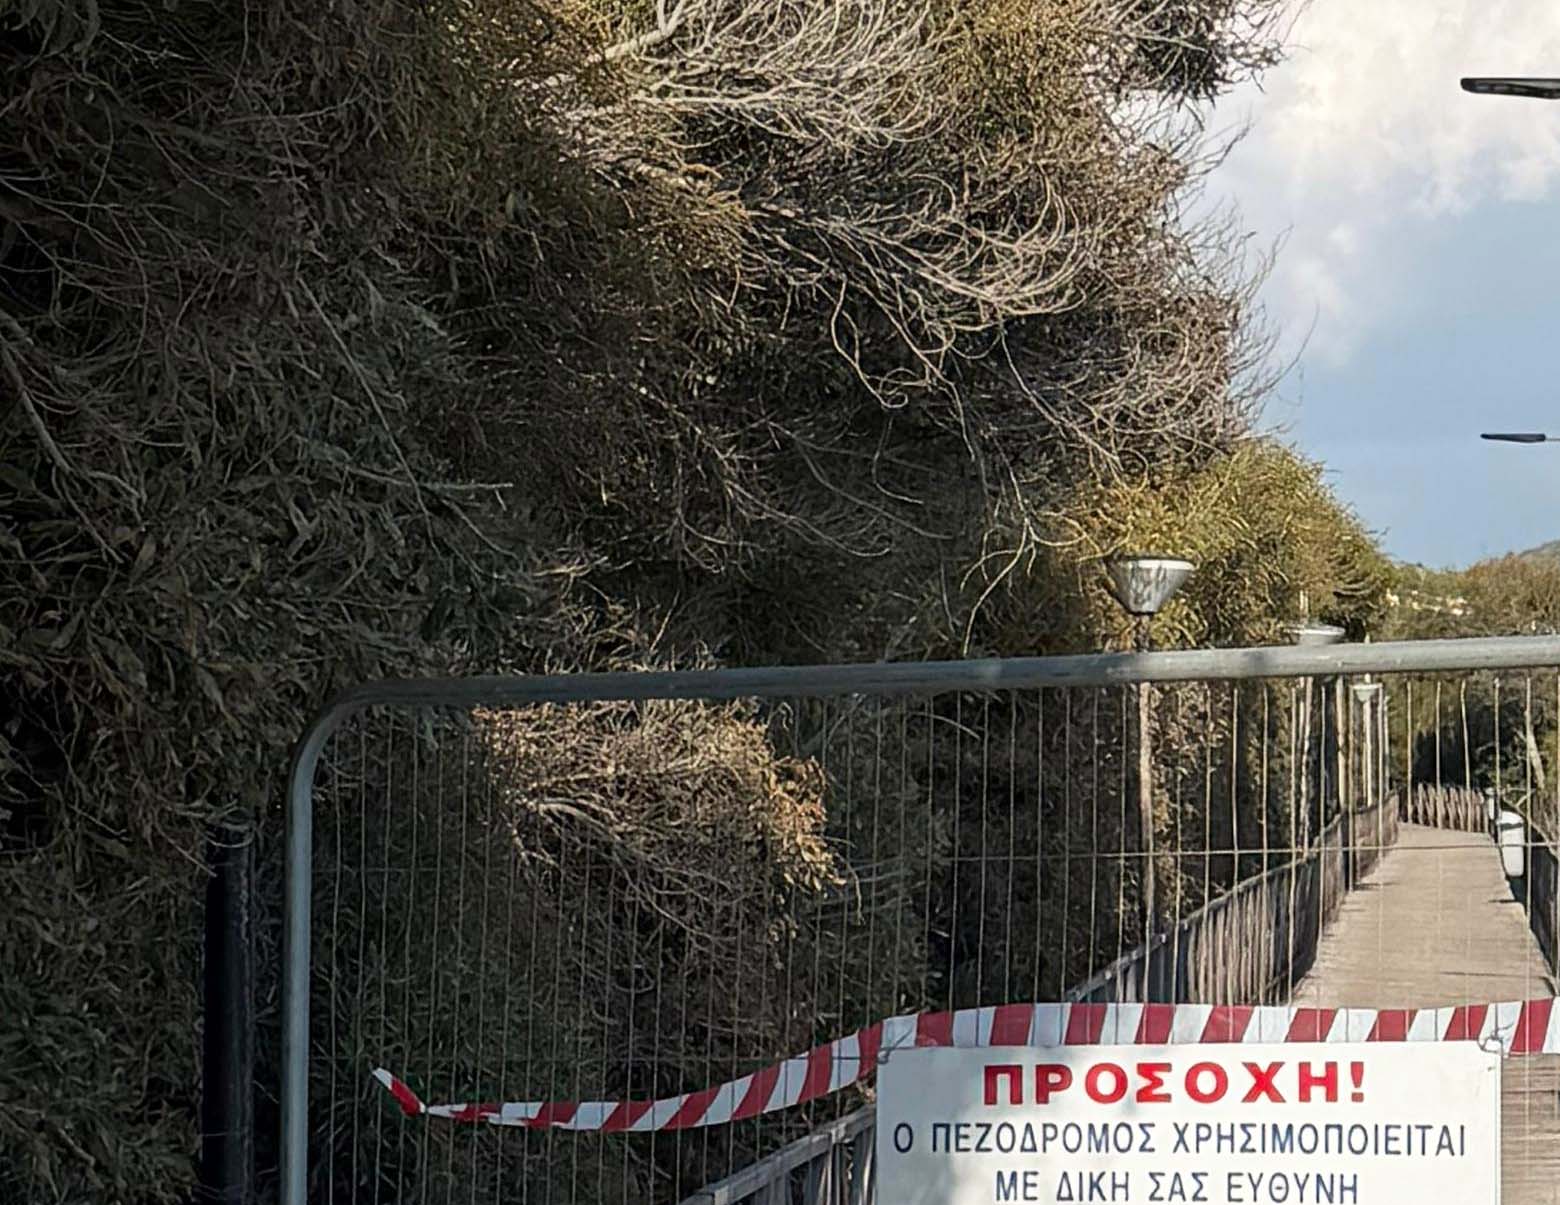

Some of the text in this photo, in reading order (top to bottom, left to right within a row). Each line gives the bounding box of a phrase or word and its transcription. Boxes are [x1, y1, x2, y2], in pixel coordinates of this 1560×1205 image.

[983, 1060, 1365, 1106] ΠΡΟΣΟΧΗ!
[893, 1121, 1466, 1157] Ο ΠΕΖΟΔΡΟΜΟΣ ΧΡΗΣΙΜΟΠΟΙΕΙΤΑΙ
[995, 1169, 1358, 1205] ΜΕ ΔΙΚΗ ΣΑΣ ΕΥΘΥΝΗ
